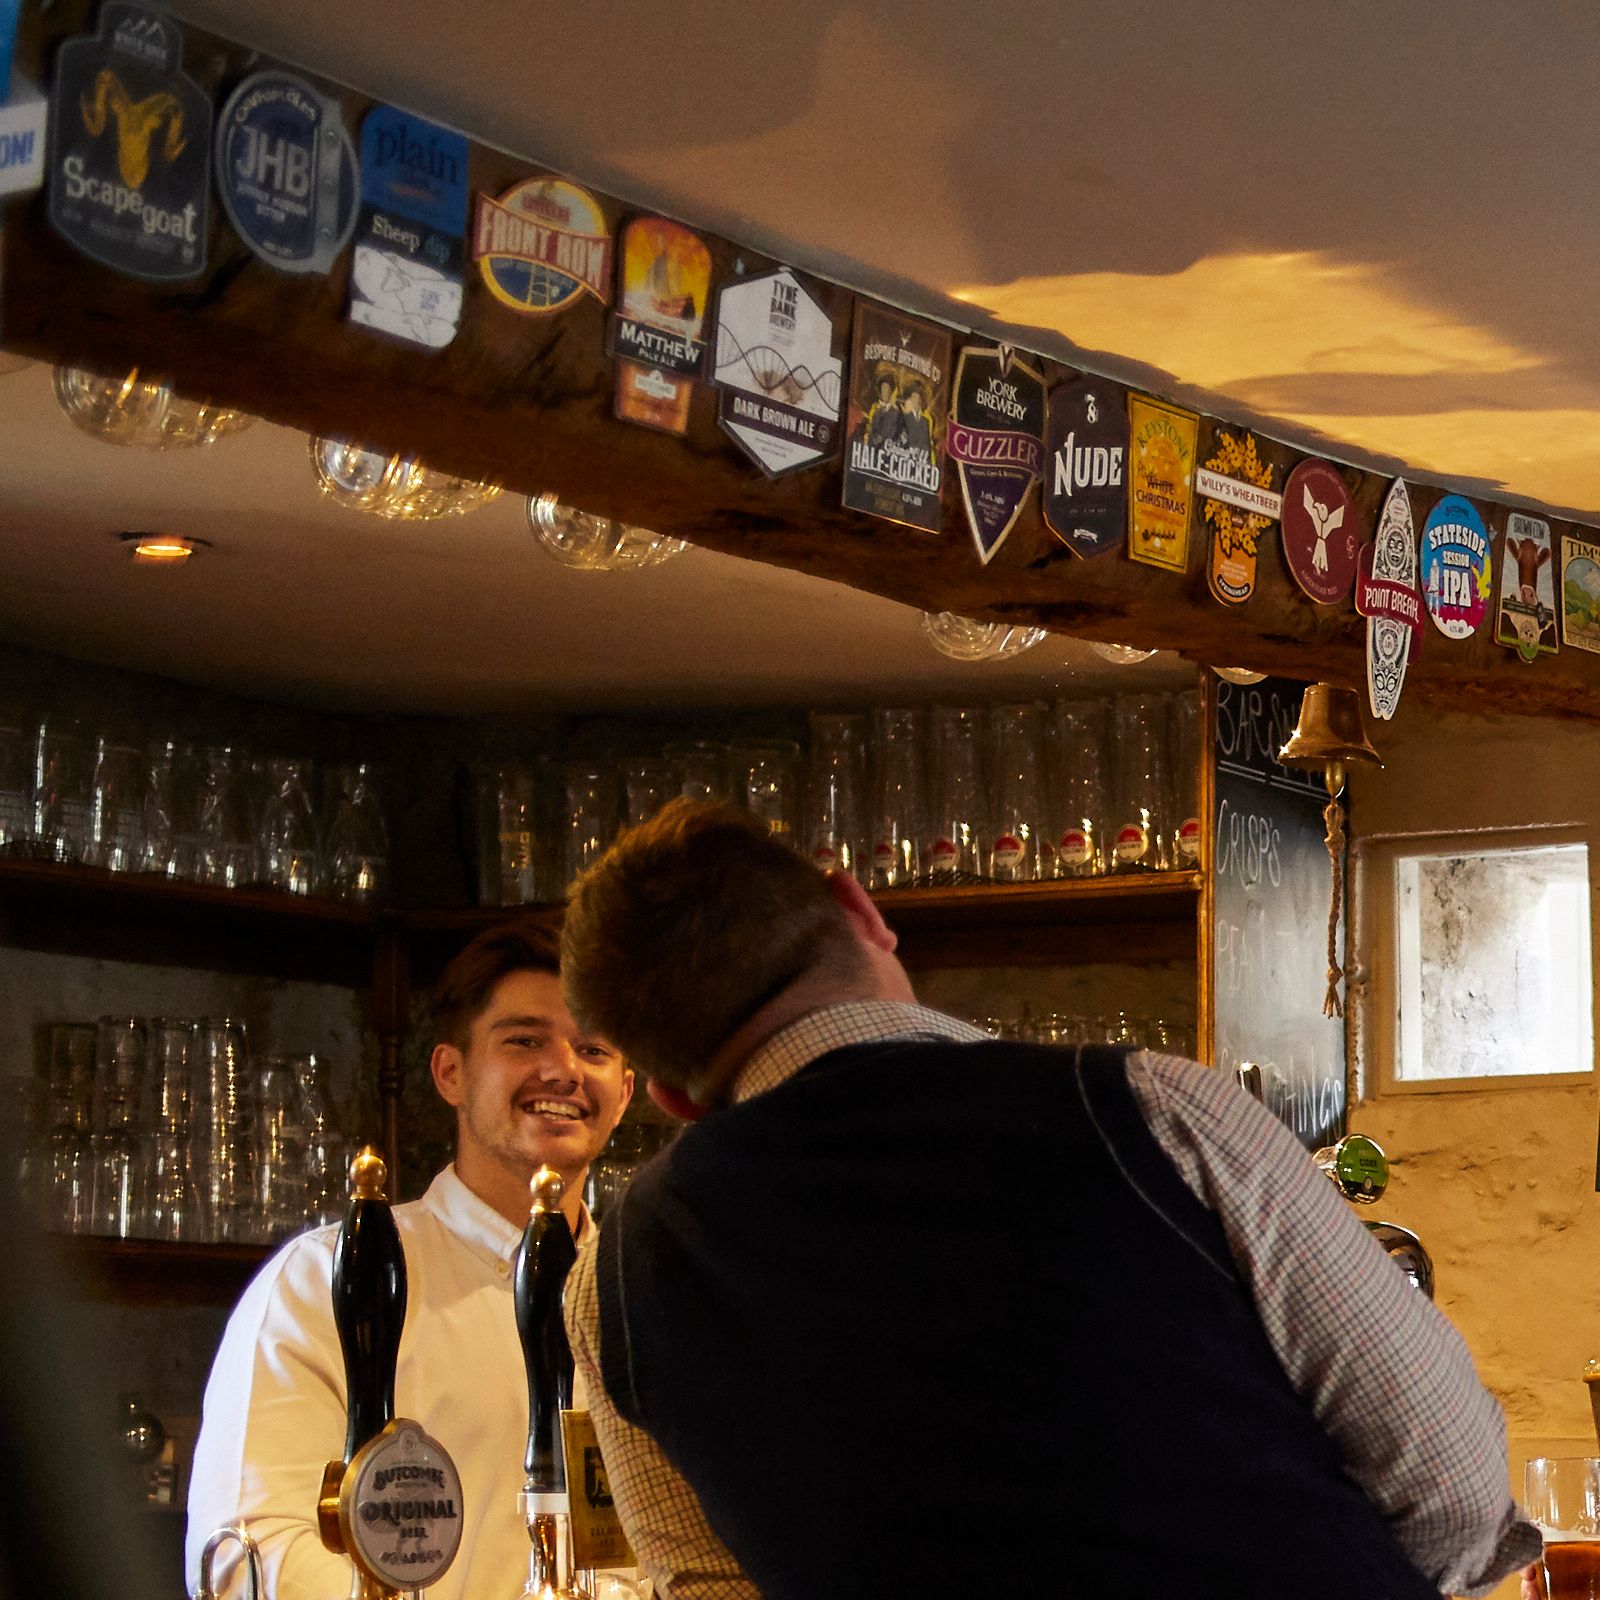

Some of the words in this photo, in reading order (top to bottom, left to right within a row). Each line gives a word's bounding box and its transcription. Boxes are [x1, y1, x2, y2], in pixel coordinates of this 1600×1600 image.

[235, 125, 309, 197] JHB
[375, 124, 457, 185] plain
[63, 156, 197, 243] Scapegoat
[372, 214, 420, 253] Sheep
[479, 200, 552, 262] FRONT
[557, 234, 606, 292] ROW
[620, 321, 700, 364] MATTHEW
[898, 348, 932, 378] BREWING
[976, 388, 1027, 421] BREWERY
[988, 376, 1018, 402] YORK
[734, 397, 761, 420] DARK
[762, 406, 797, 432] BROWN
[797, 419, 815, 438] ALE
[851, 440, 940, 491] HALF-COCKED
[953, 430, 1038, 468] GUZZLER
[1136, 489, 1186, 516] CHRISTMAS
[1200, 475, 1231, 496] WILLY'S
[1231, 486, 1279, 511] WHEATBEER
[1428, 524, 1486, 560] STATESIDE
[1442, 551, 1470, 568] SESSION
[1364, 585, 1390, 609] POINT
[1390, 590, 1420, 623] BREAK
[1443, 570, 1472, 608] IPA
[1216, 680, 1268, 761] BAR
[373, 1465, 445, 1490] BUTCOMBE
[363, 1499, 457, 1526] ORIGINAL
